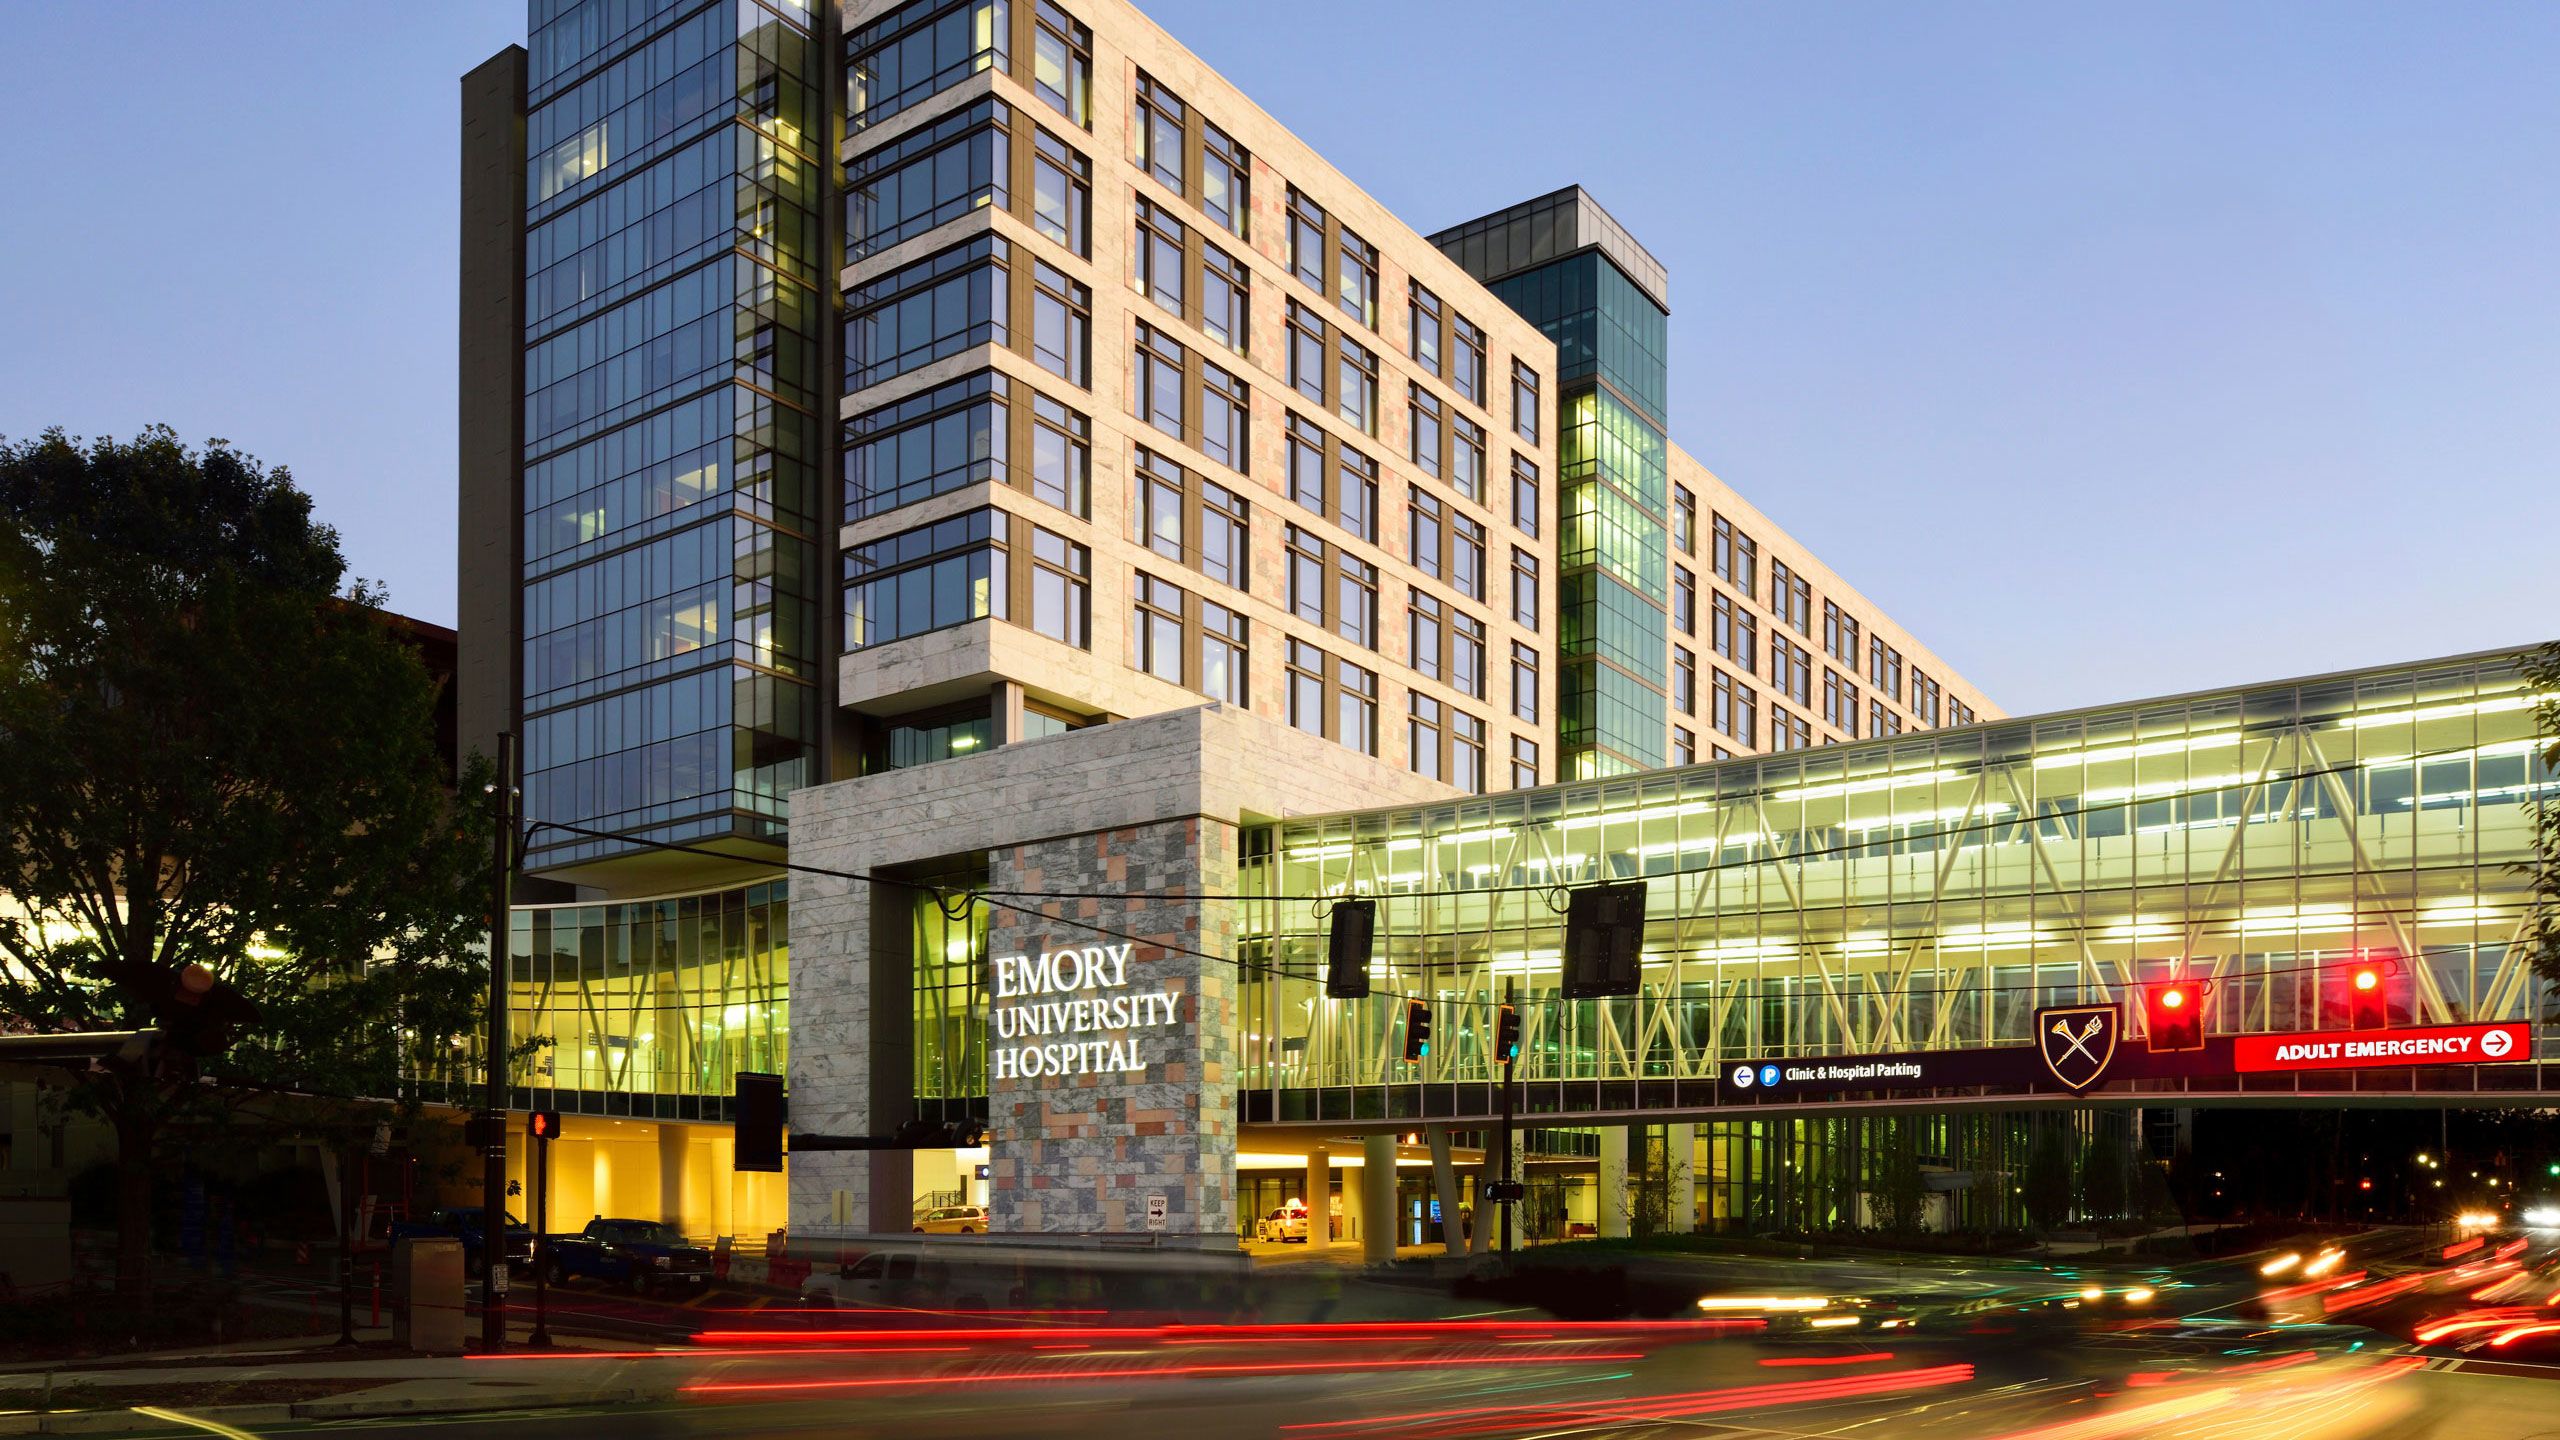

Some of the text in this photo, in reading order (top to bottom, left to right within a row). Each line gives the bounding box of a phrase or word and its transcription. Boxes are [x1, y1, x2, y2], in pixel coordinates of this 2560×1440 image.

[995, 943, 1132, 997] EMORY
[995, 991, 1180, 1038] UNIVERSITY
[995, 1039, 1146, 1078] HOSPITAL
[2275, 1037, 2472, 1060] ADULT EMERGENCY
[1764, 1062, 1921, 1082] P Clinic & Hospital Parking
[1150, 1199, 1165, 1207] KEEP
